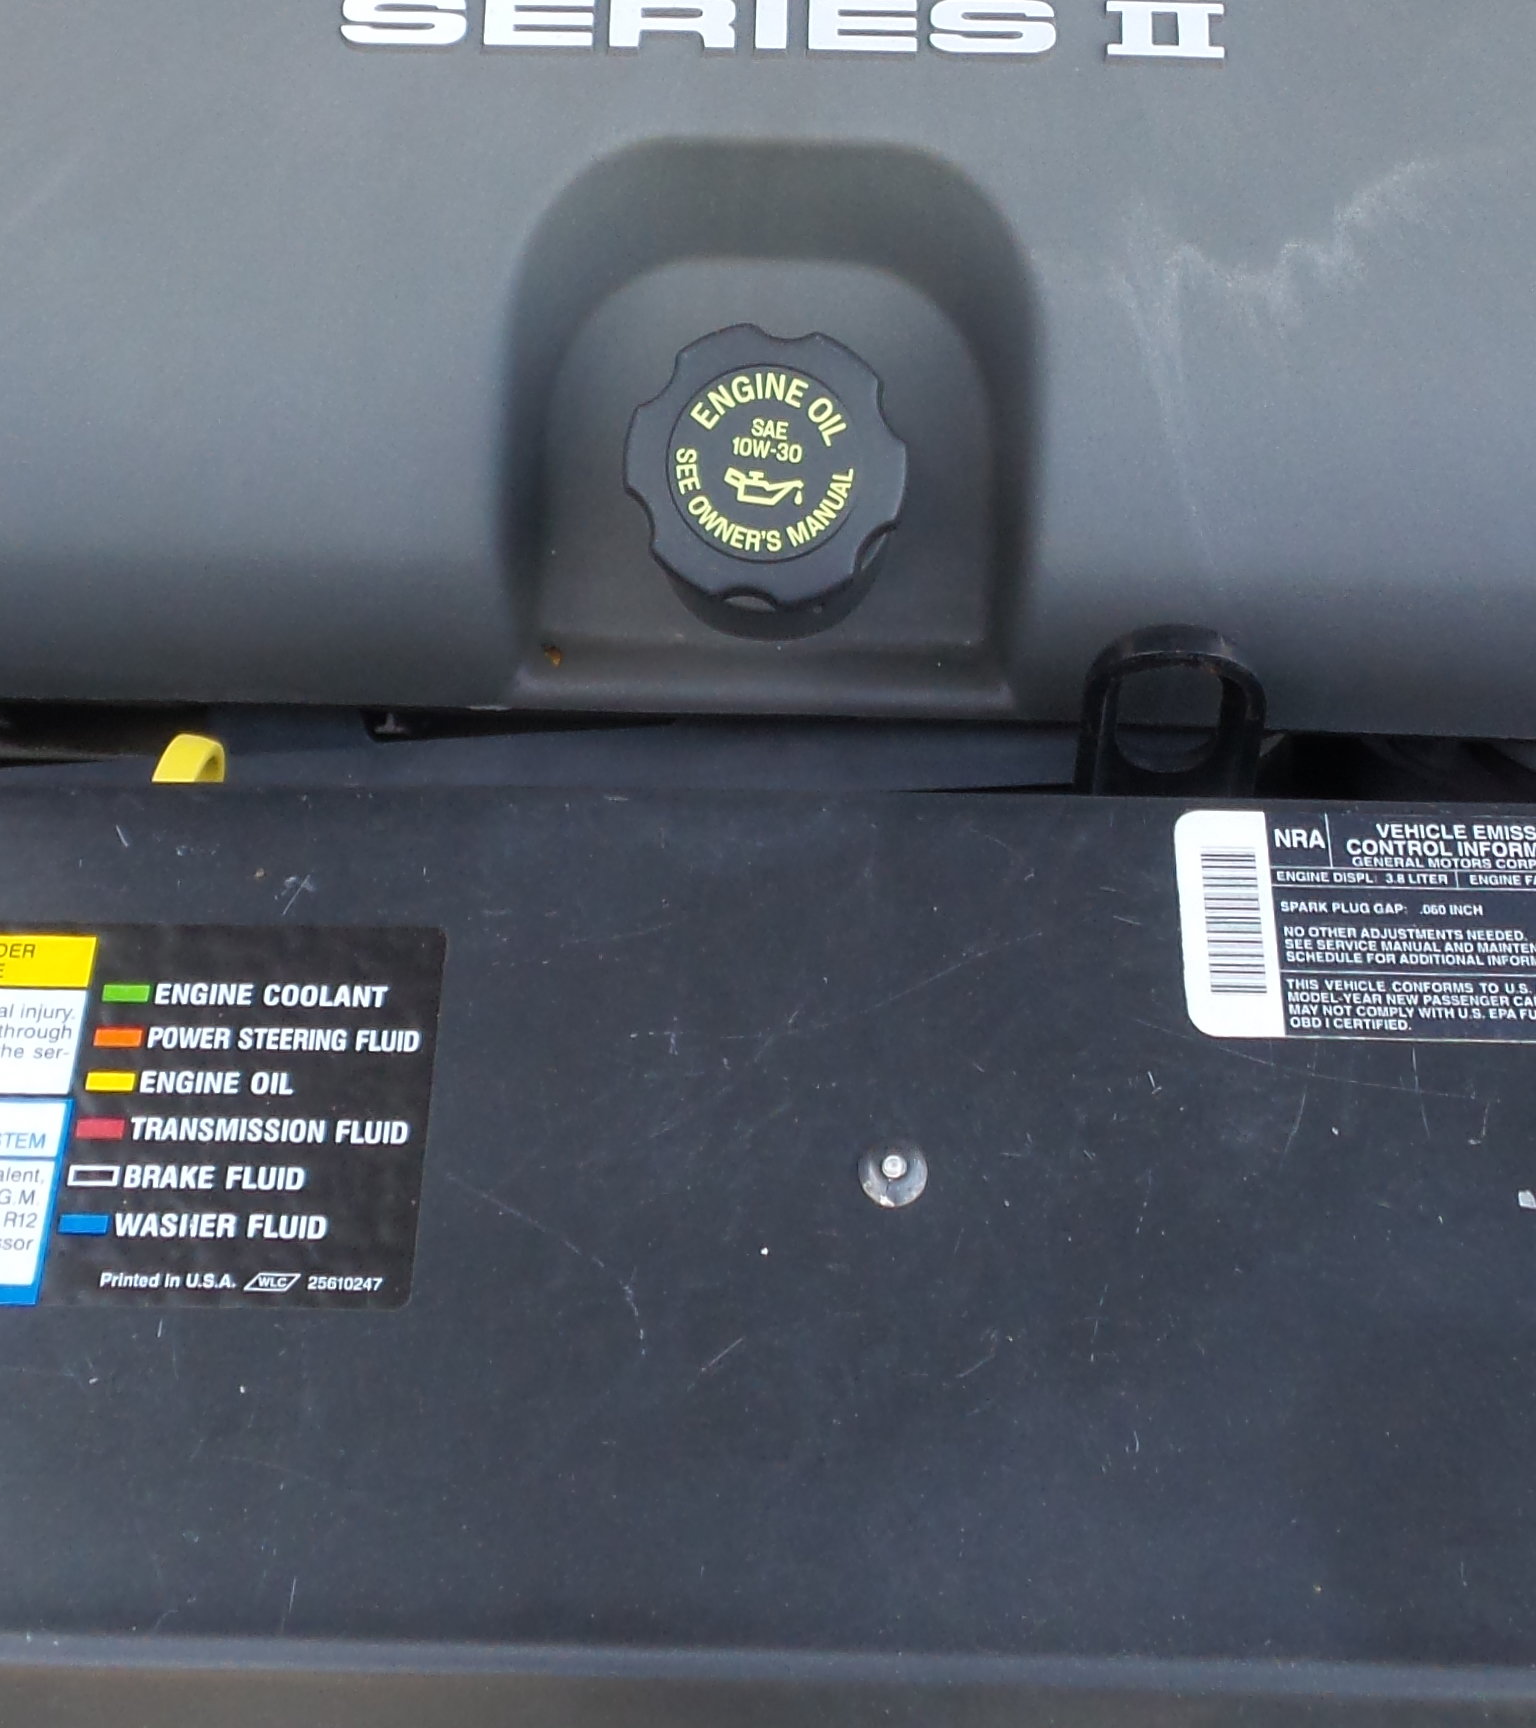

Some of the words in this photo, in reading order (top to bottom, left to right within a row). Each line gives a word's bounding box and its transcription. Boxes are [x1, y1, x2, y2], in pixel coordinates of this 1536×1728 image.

[690, 372, 809, 430] ENGINE
[808, 397, 847, 447] OIL
[751, 418, 789, 440] SAE
[732, 437, 803, 464] 10W-30
[675, 447, 701, 495] SEE
[688, 495, 782, 552] OWNER'S
[786, 468, 854, 547] MANUAL
[1274, 829, 1326, 849] NRA
[1376, 824, 1467, 840] VEHICLE
[1346, 839, 1453, 857] CONTROL
[1352, 857, 1424, 868] GENERAL
[1428, 857, 1491, 869] MOTORS
[1276, 870, 1329, 883] ENGINE
[1385, 872, 1405, 884] 3.8
[1408, 873, 1448, 885] LITER
[1469, 874, 1521, 886] ENGINE
[1280, 901, 1328, 914] SPARK
[1332, 902, 1369, 915] PLUG
[1450, 904, 1483, 917] INCH
[1284, 927, 1305, 938] NO
[1308, 927, 1357, 939] OTHER
[1361, 928, 1463, 941] ADJUSTMENTS
[1466, 929, 1528, 942] NEEDED.
[1284, 939, 1313, 950] SEE
[1316, 940, 1377, 952] SERVICE
[1381, 941, 1440, 953] MANUAL
[1445, 942, 1473, 954] AND
[1287, 951, 1362, 964] SCHEDULE
[1367, 953, 1396, 965] FOR
[1399, 953, 1484, 967] ADDITIONAL
[154, 983, 254, 1006] ENGINE
[263, 984, 389, 1008] COOLANT
[147, 1027, 231, 1050] POWER
[237, 1028, 347, 1052] STEERING
[354, 1030, 420, 1053] FLUID
[139, 1071, 240, 1094] ENGINE
[250, 1072, 294, 1095] OIL
[131, 1117, 325, 1143] TRANSMISSION
[334, 1120, 409, 1145] FLUID
[123, 1165, 215, 1190] BRAKE
[225, 1165, 306, 1191] FLUID
[3, 1211, 39, 1229] R12
[114, 1212, 237, 1238] WASHER
[246, 1214, 328, 1240] FLUID
[99, 1272, 160, 1289] Printed
[186, 1272, 235, 1289] U.S.A.
[258, 1276, 288, 1289] WLC
[307, 1275, 383, 1292] 25610247
